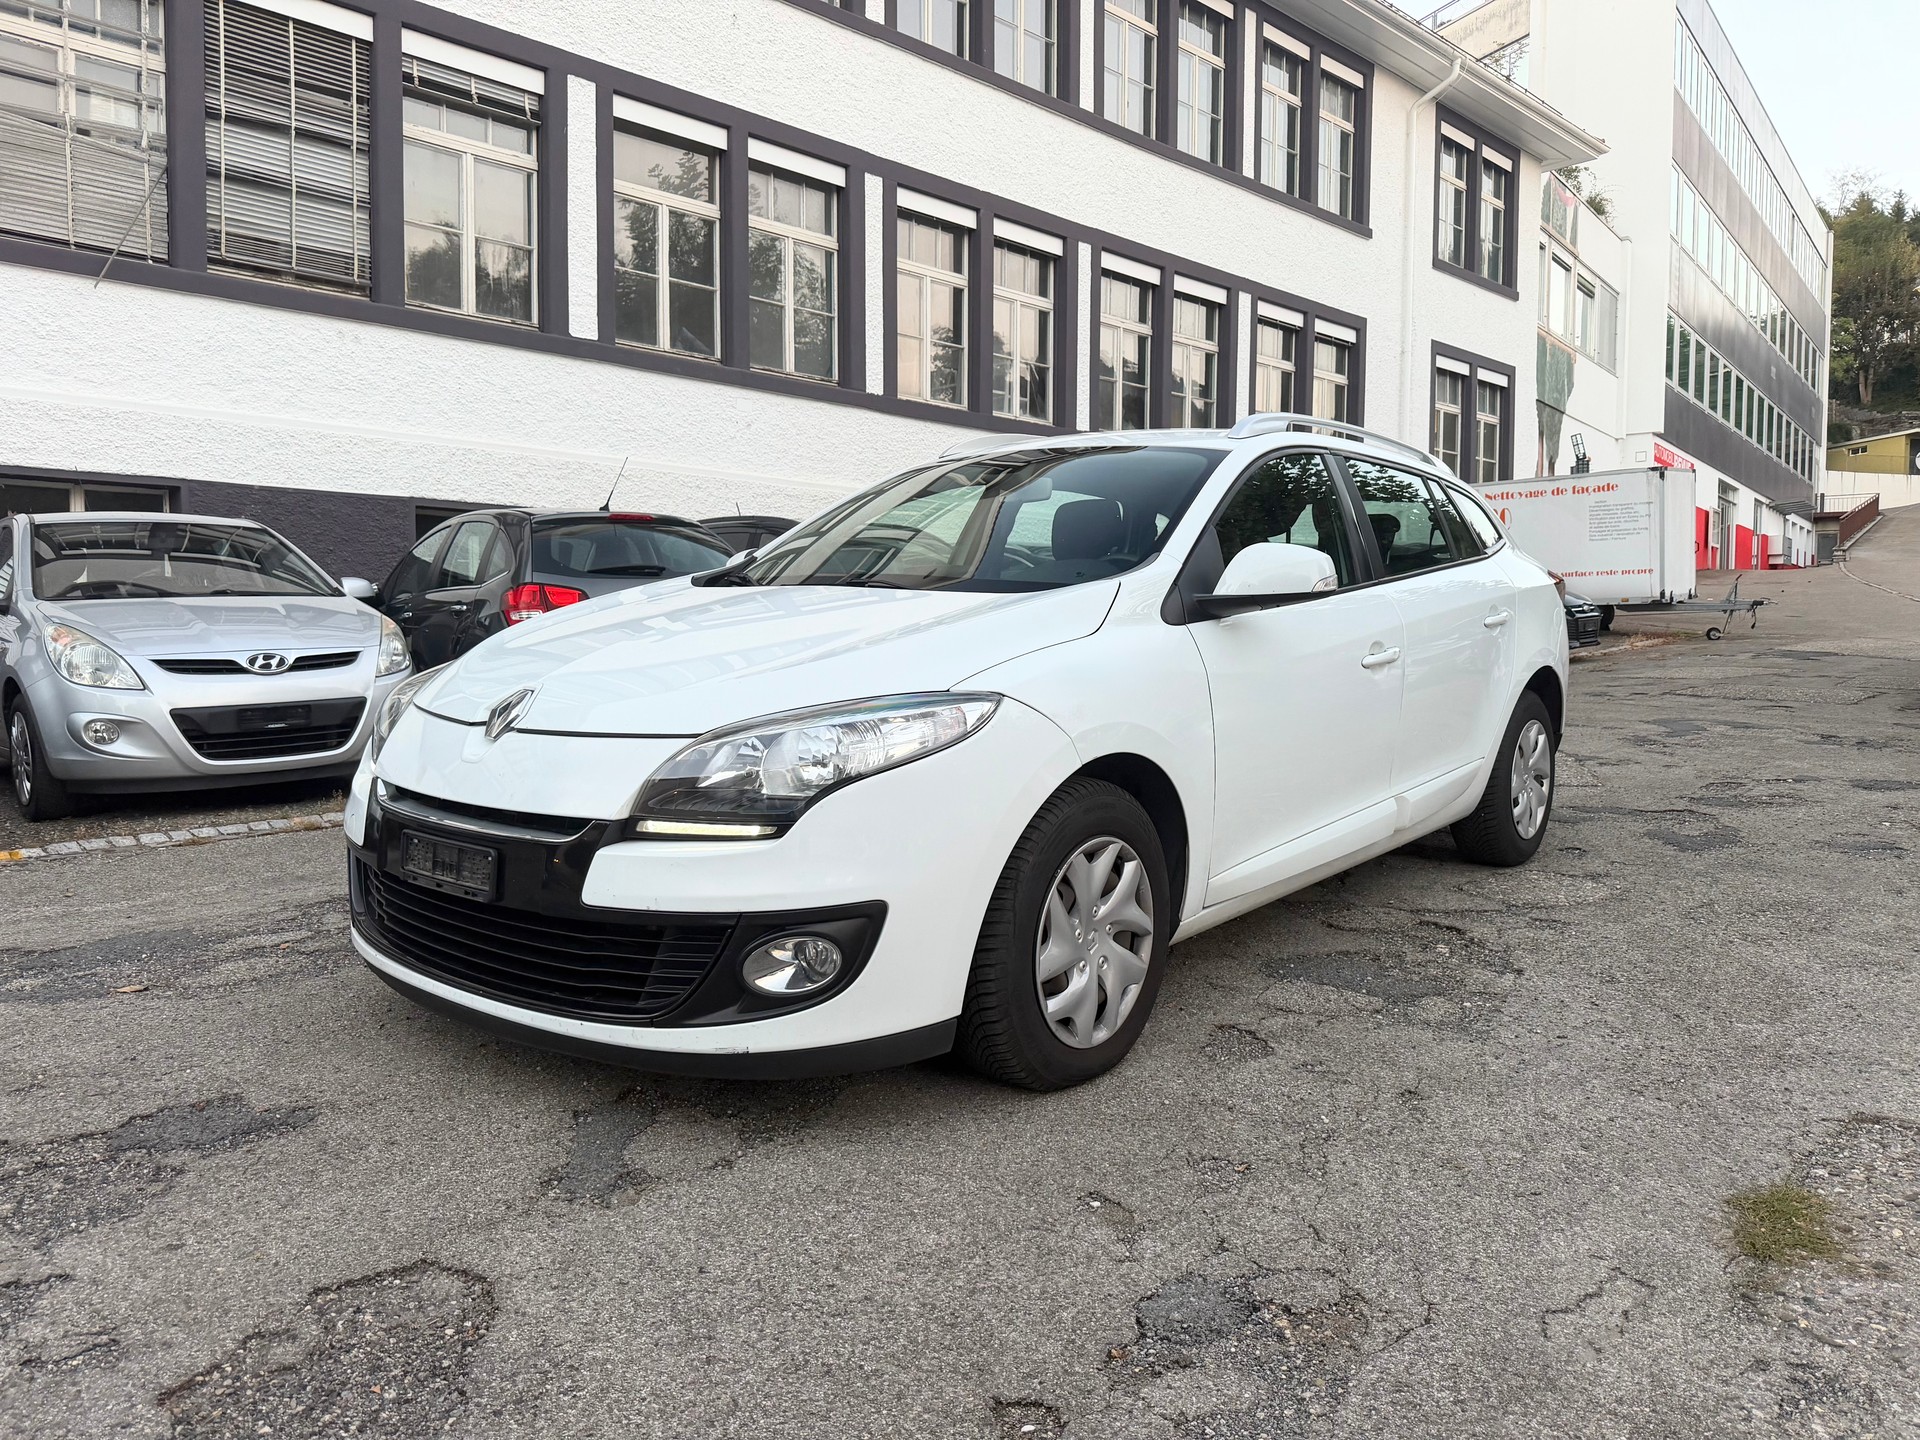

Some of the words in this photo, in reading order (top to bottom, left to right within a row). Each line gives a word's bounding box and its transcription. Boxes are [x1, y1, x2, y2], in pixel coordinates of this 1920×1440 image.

[1485, 489, 1547, 500] Nettoyage
[1551, 486, 1568, 497] de
[1571, 482, 1619, 496] façade
[1561, 570, 1594, 578] surface
[1621, 567, 1654, 576] propre
